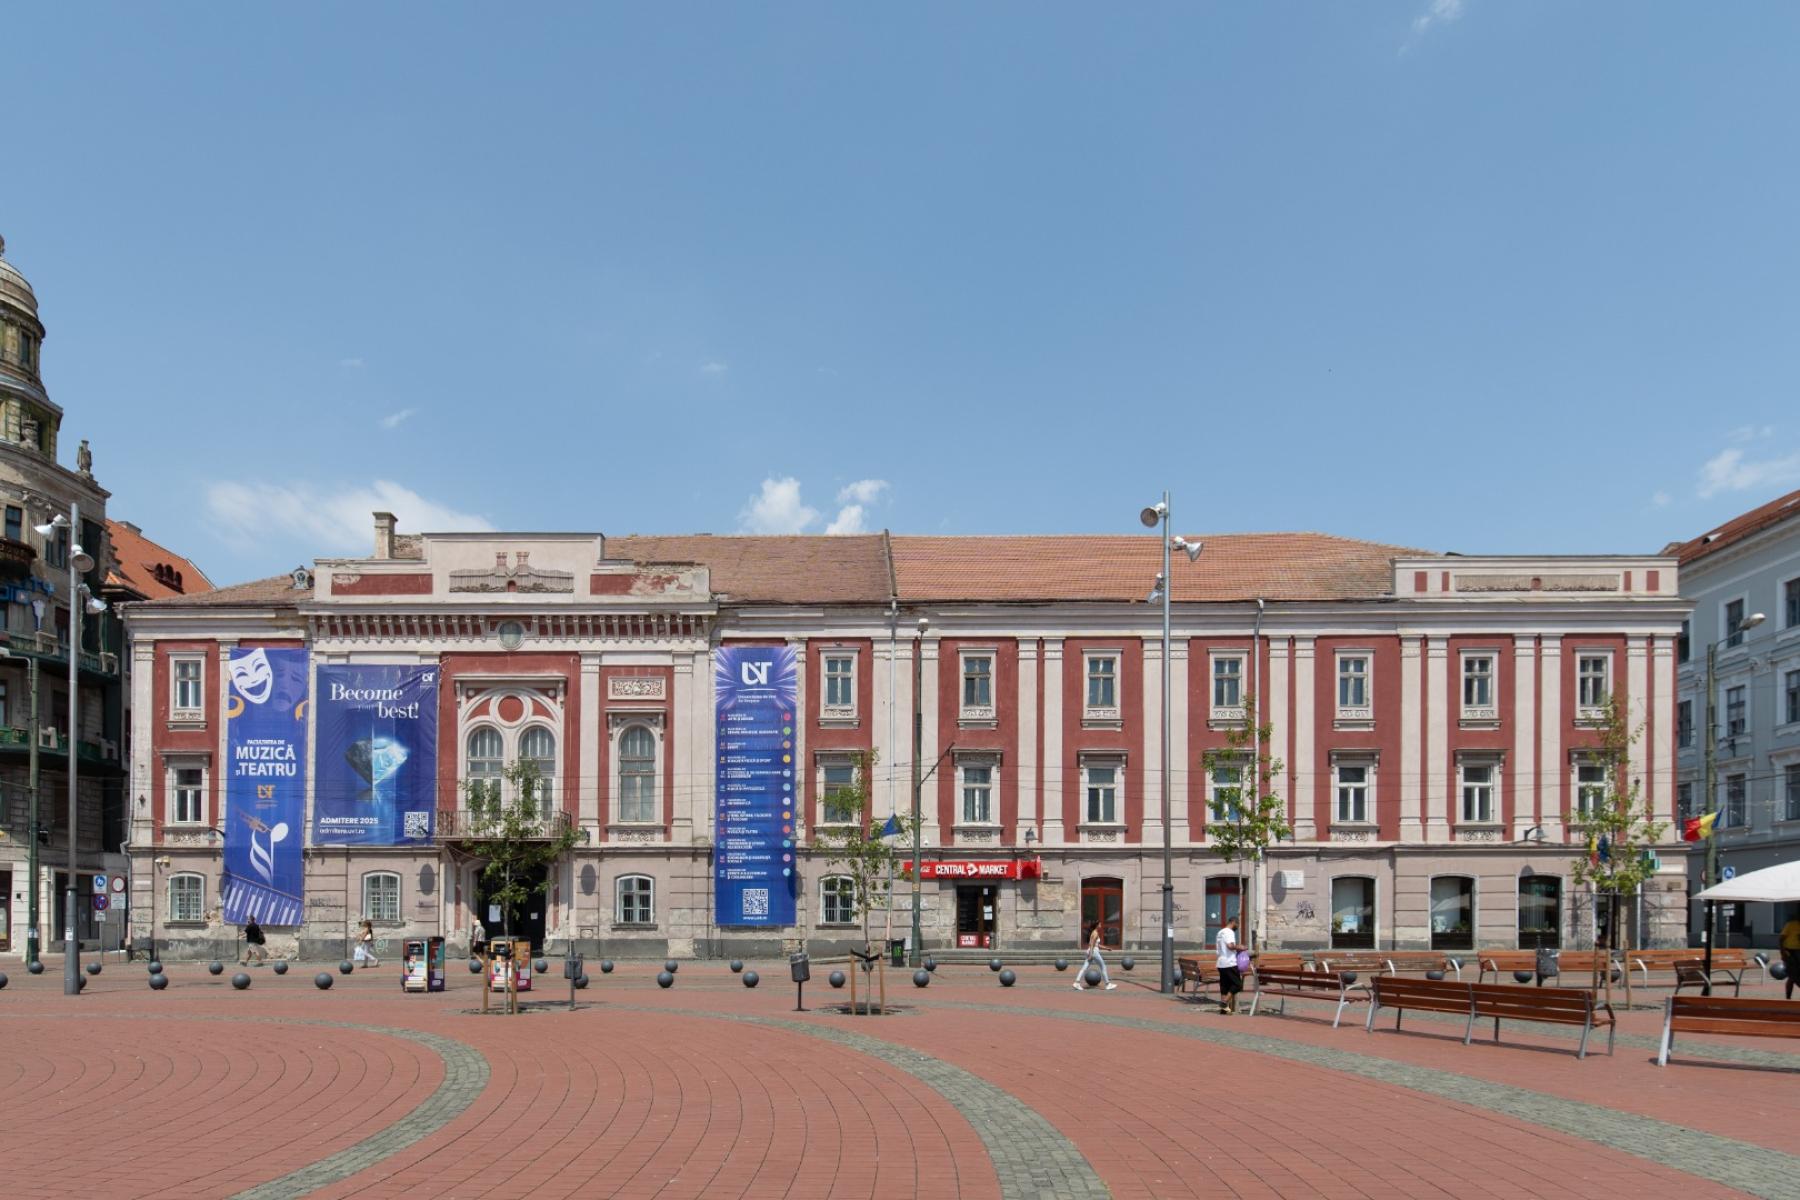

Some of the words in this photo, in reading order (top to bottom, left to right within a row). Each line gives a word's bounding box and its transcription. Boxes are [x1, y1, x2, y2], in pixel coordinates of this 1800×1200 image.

[329, 682, 403, 701] Become
[378, 702, 419, 719] best!
[236, 744, 296, 760] MUZICĂ
[239, 762, 297, 776] TEATRU
[935, 864, 966, 875] CENTRAL
[979, 865, 1008, 875] MARKET
